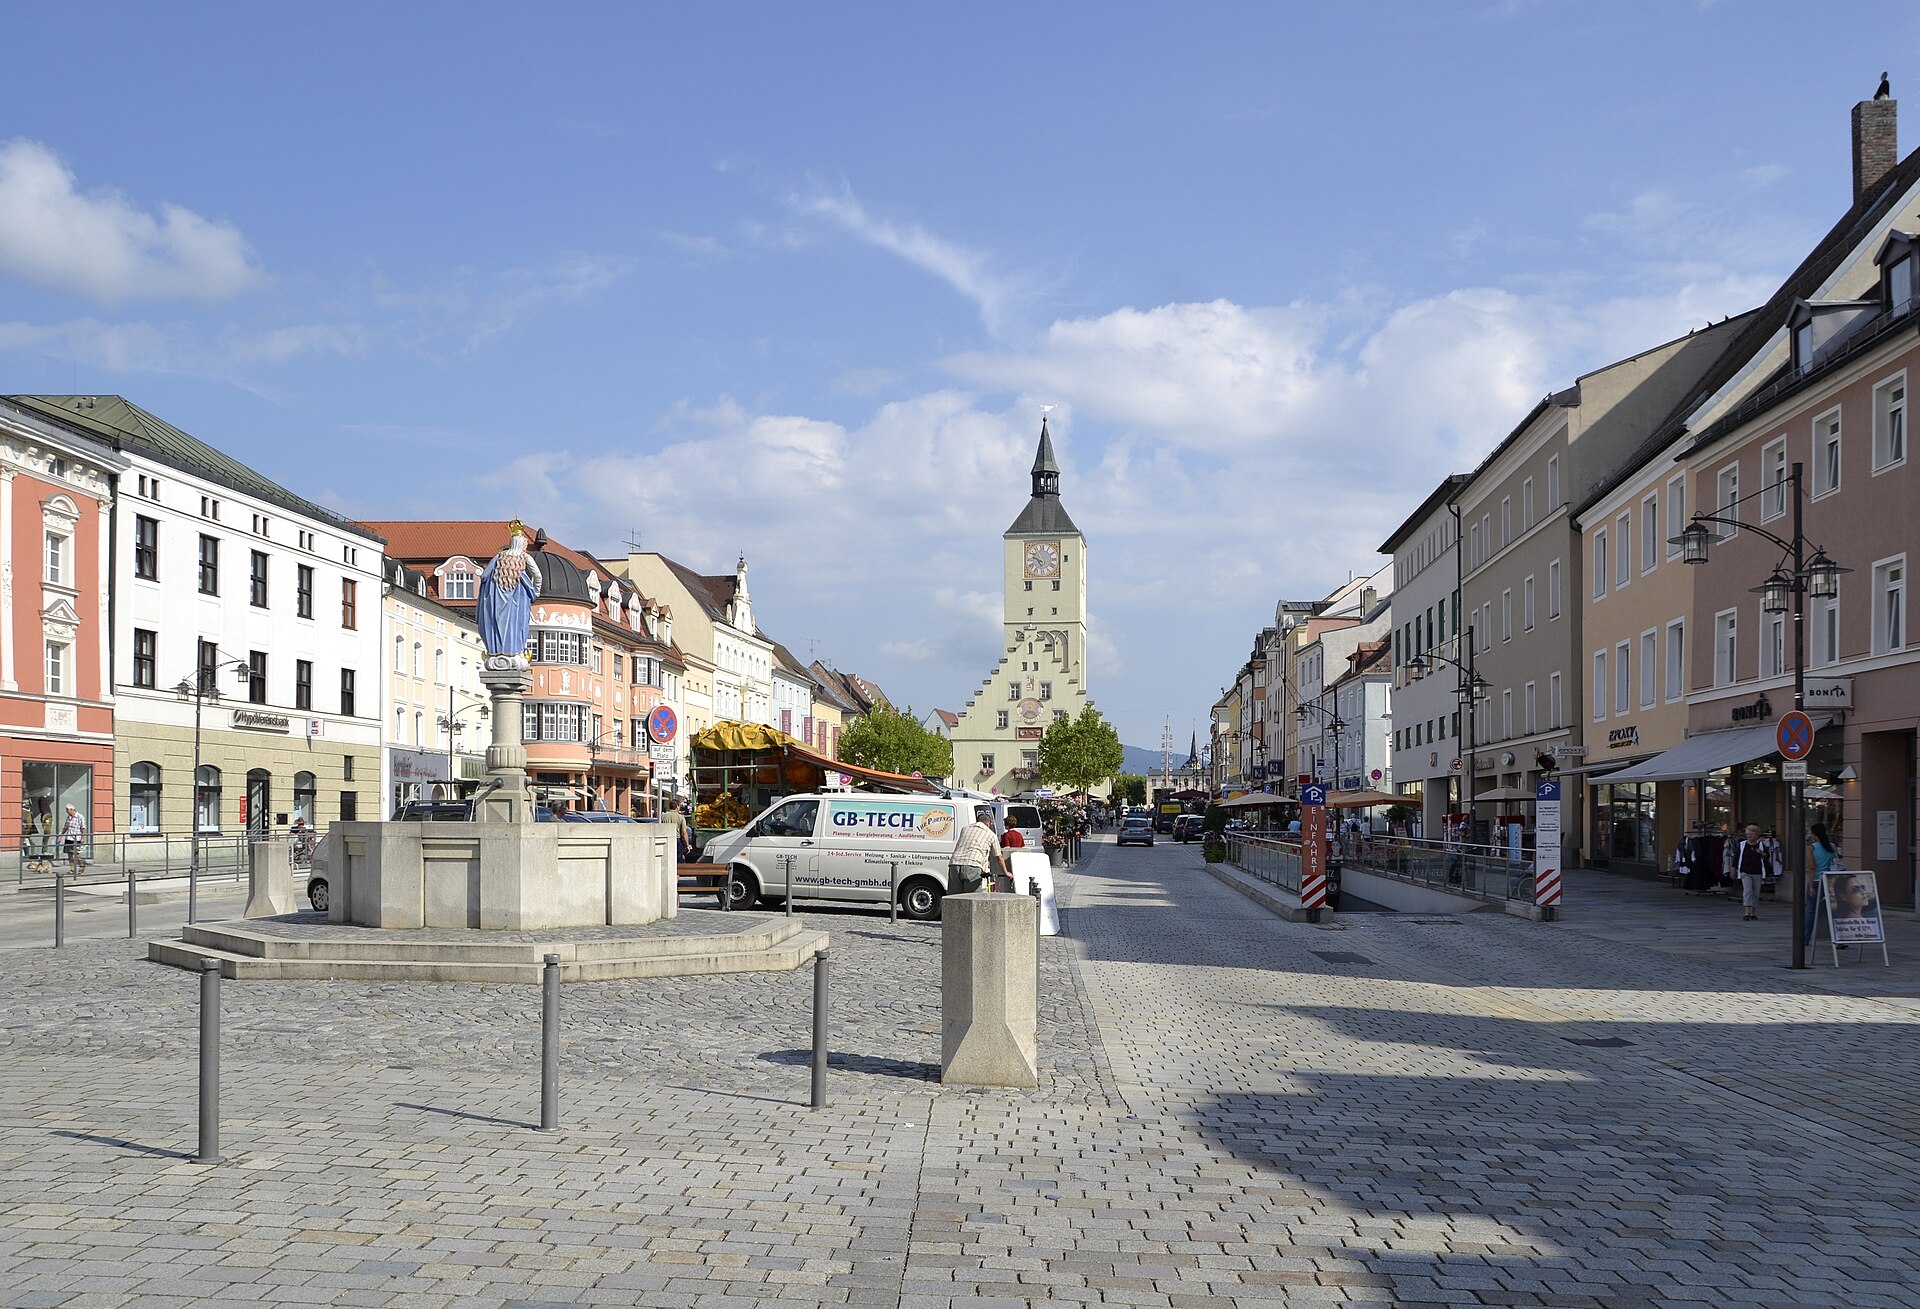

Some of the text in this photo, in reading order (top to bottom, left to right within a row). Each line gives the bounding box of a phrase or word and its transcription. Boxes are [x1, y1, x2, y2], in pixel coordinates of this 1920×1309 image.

[1809, 685, 1845, 697] BONITA
[1732, 693, 1772, 721] BONITA
[242, 711, 289, 727] HypoVereinsbank
[1608, 726, 1637, 742] EPOXY
[1310, 790, 1319, 801] P
[1544, 786, 1552, 795] P
[833, 811, 915, 828] GB-TECH
[1310, 806, 1318, 873] EINFAHRT
